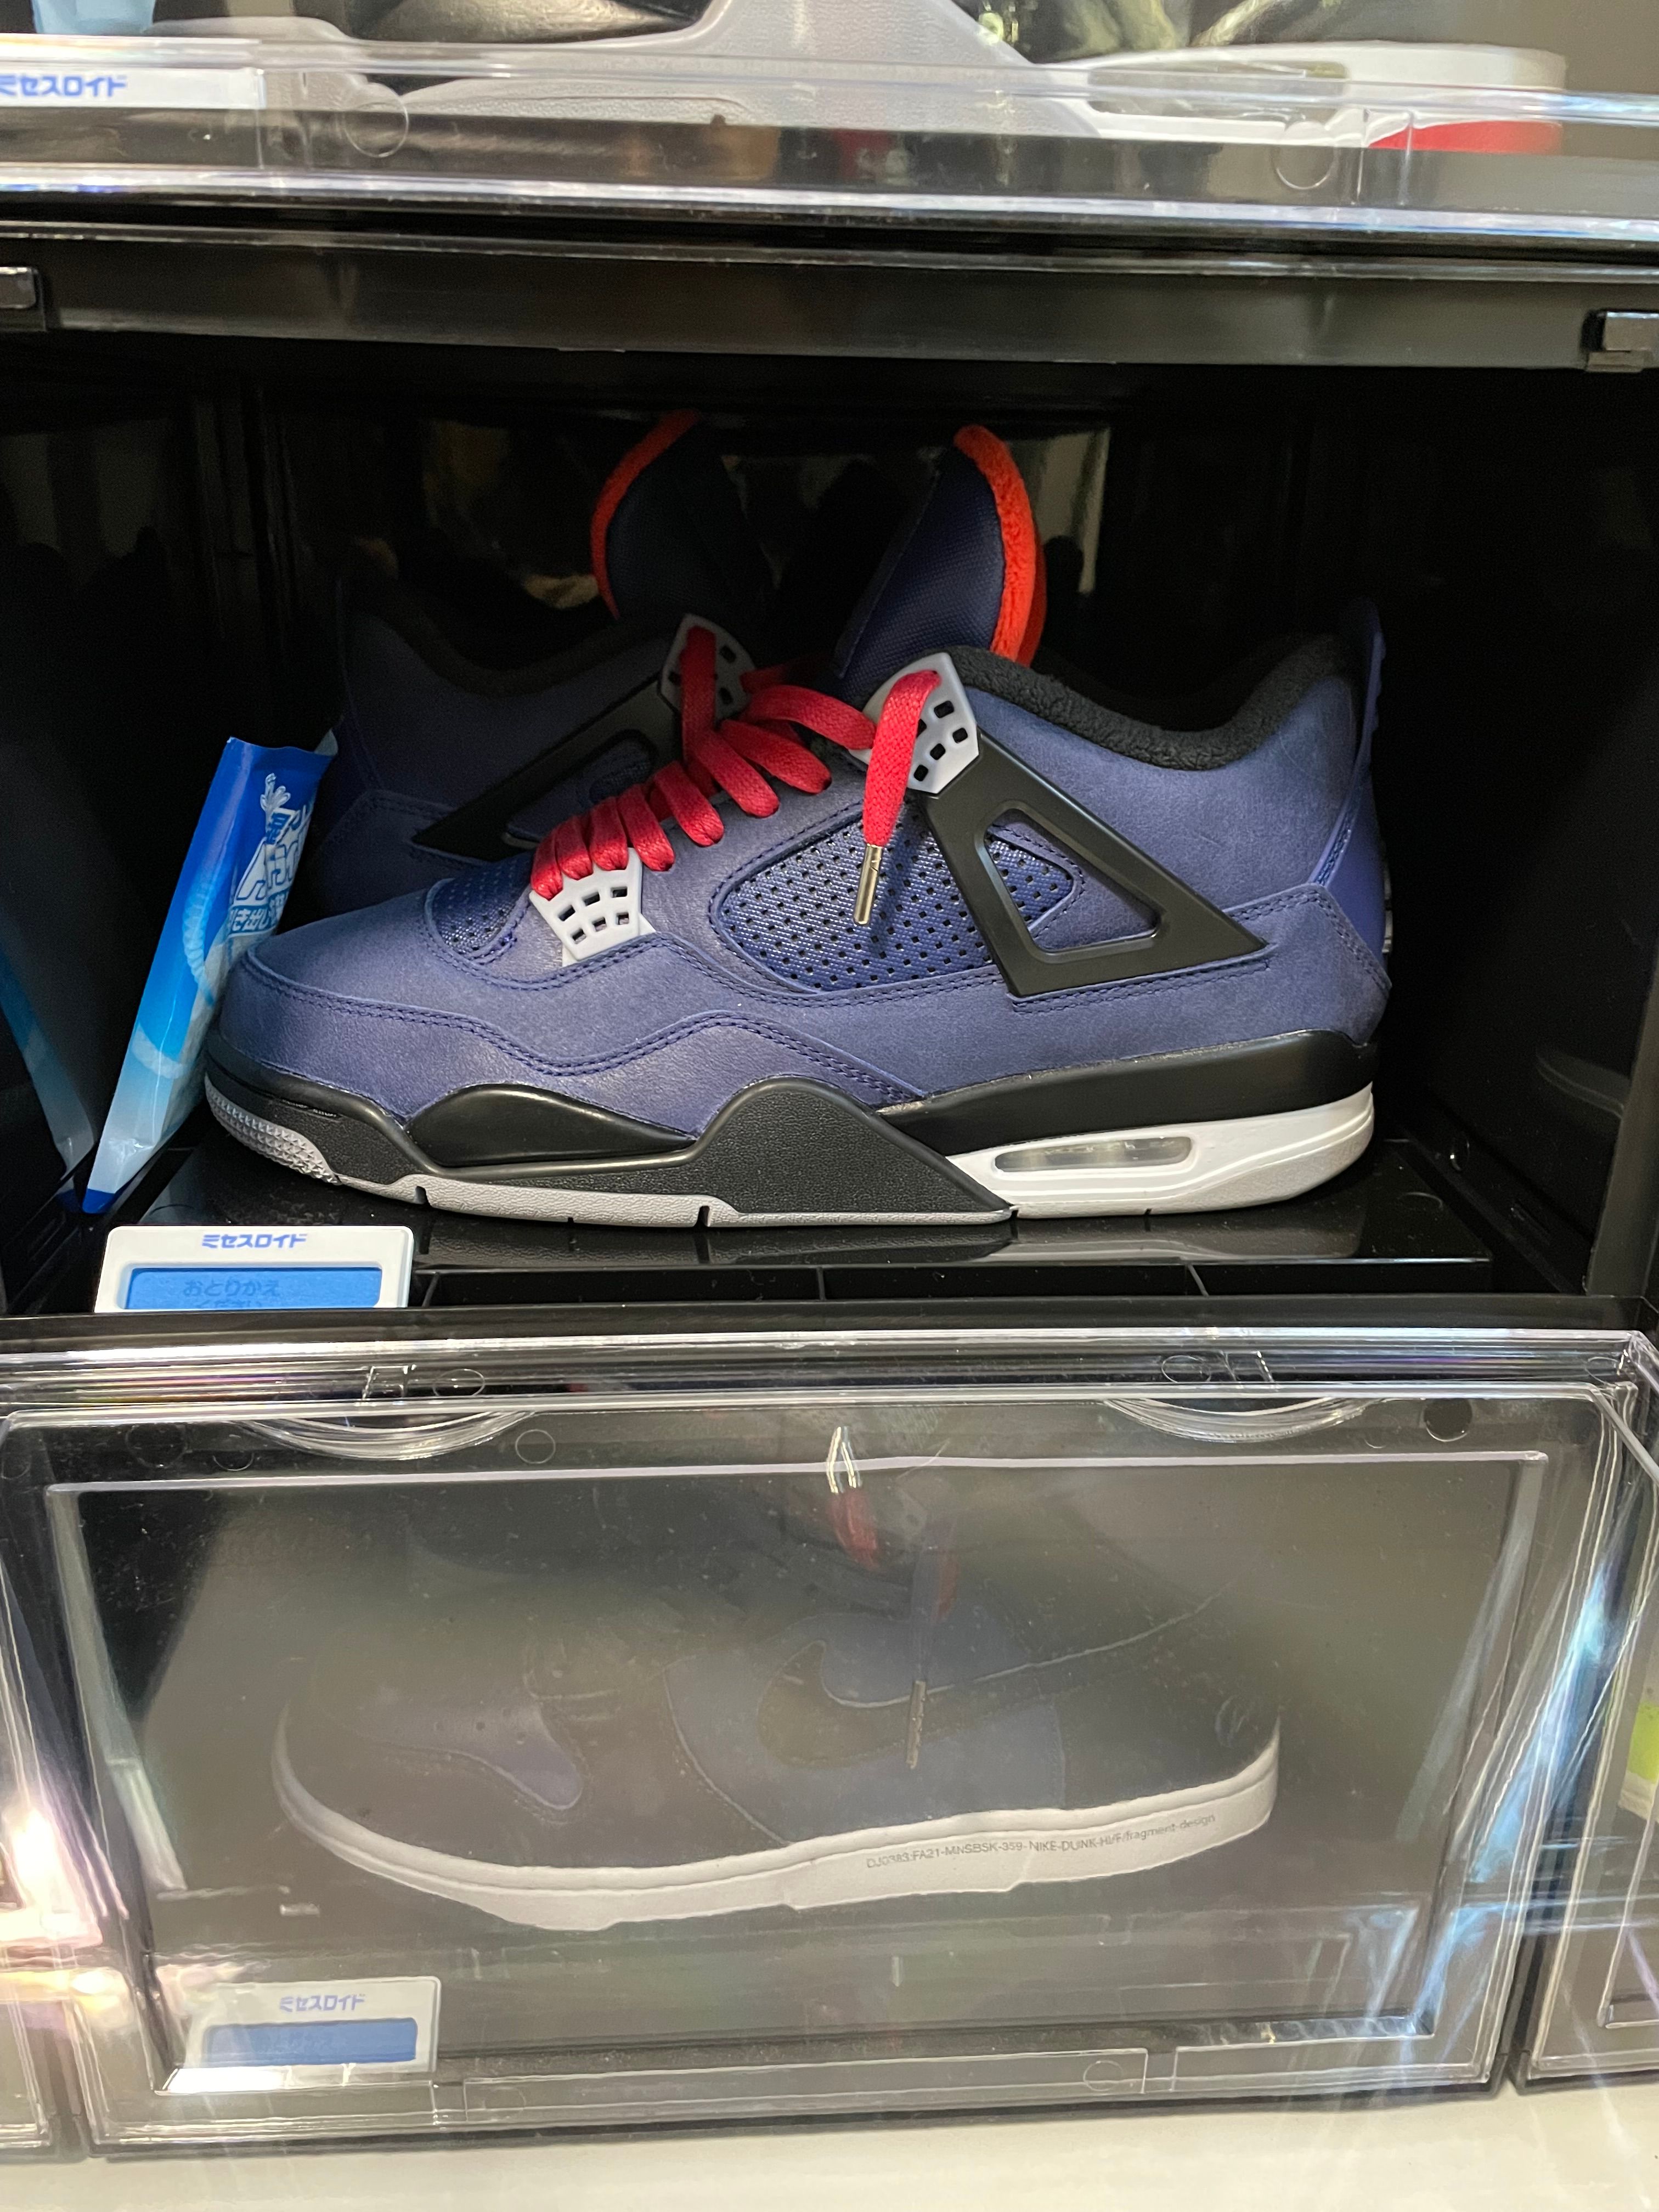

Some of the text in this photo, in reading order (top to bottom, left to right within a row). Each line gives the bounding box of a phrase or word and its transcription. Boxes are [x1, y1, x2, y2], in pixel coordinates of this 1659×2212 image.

[201, 1233, 308, 1249] ミセスロイド
[183, 1278, 280, 1297] おとりかえ
[279, 1993, 366, 2012] ミセスロイド
